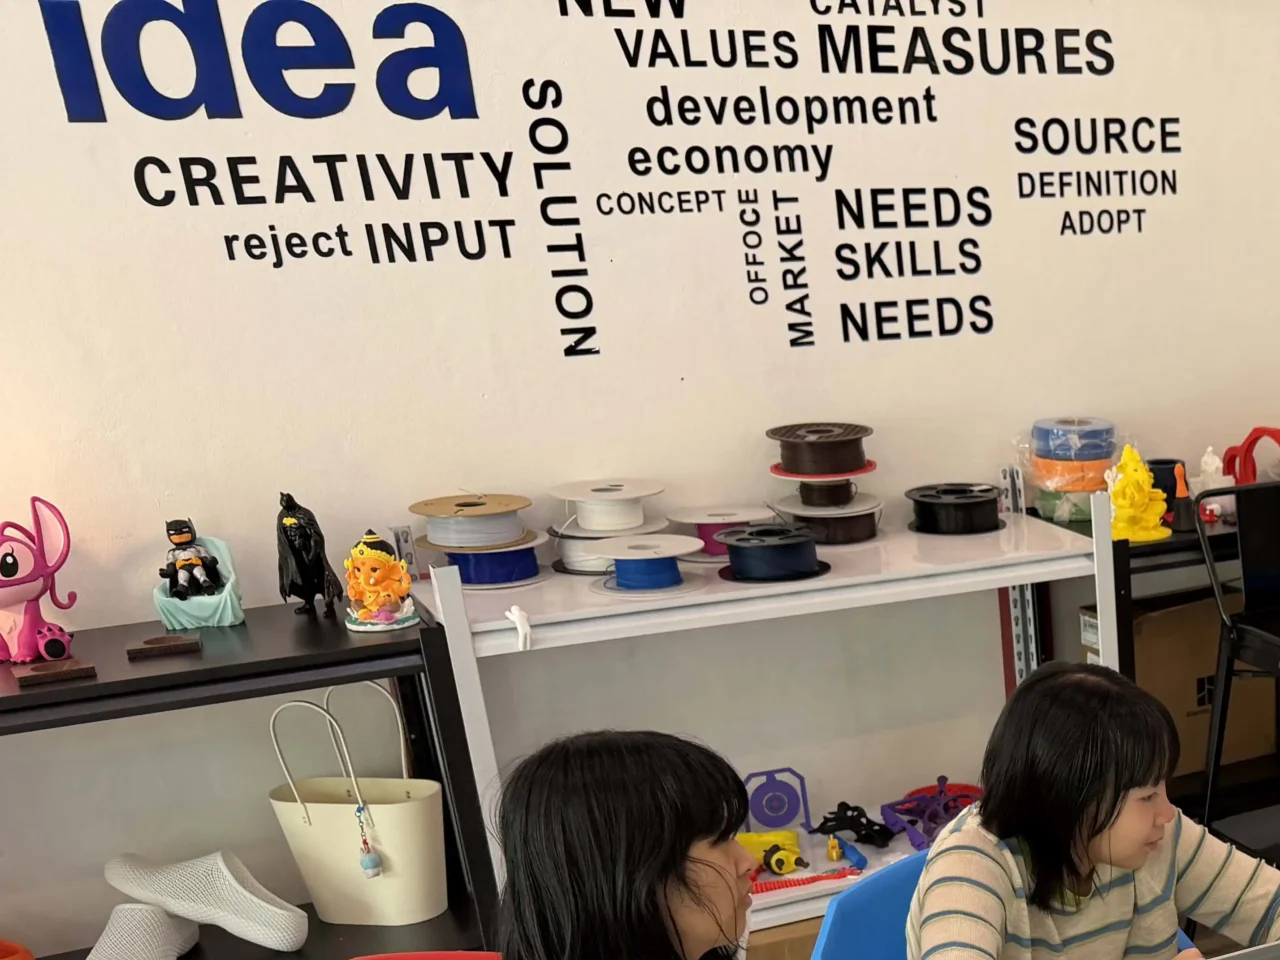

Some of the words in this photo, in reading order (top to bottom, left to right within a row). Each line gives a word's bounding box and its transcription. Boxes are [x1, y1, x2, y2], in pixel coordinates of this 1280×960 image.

[614, 28, 799, 69] VALUES
[818, 24, 1115, 76] MEASURES
[647, 85, 938, 134] development
[1014, 116, 1182, 155] SOURCE
[133, 151, 514, 207] CREATIVITY
[627, 143, 834, 182] economy
[1017, 169, 1178, 199] DEFINITION
[522, 78, 600, 357] SOLUTION
[596, 189, 726, 216] CONCEPT
[834, 186, 993, 230] NEEDS
[1060, 208, 1146, 236] ADOPT
[223, 223, 353, 269] reject
[364, 219, 516, 264] INPUT
[834, 238, 982, 281] SKILLS
[771, 189, 815, 348] MARKET
[839, 295, 994, 342] NEEDS
